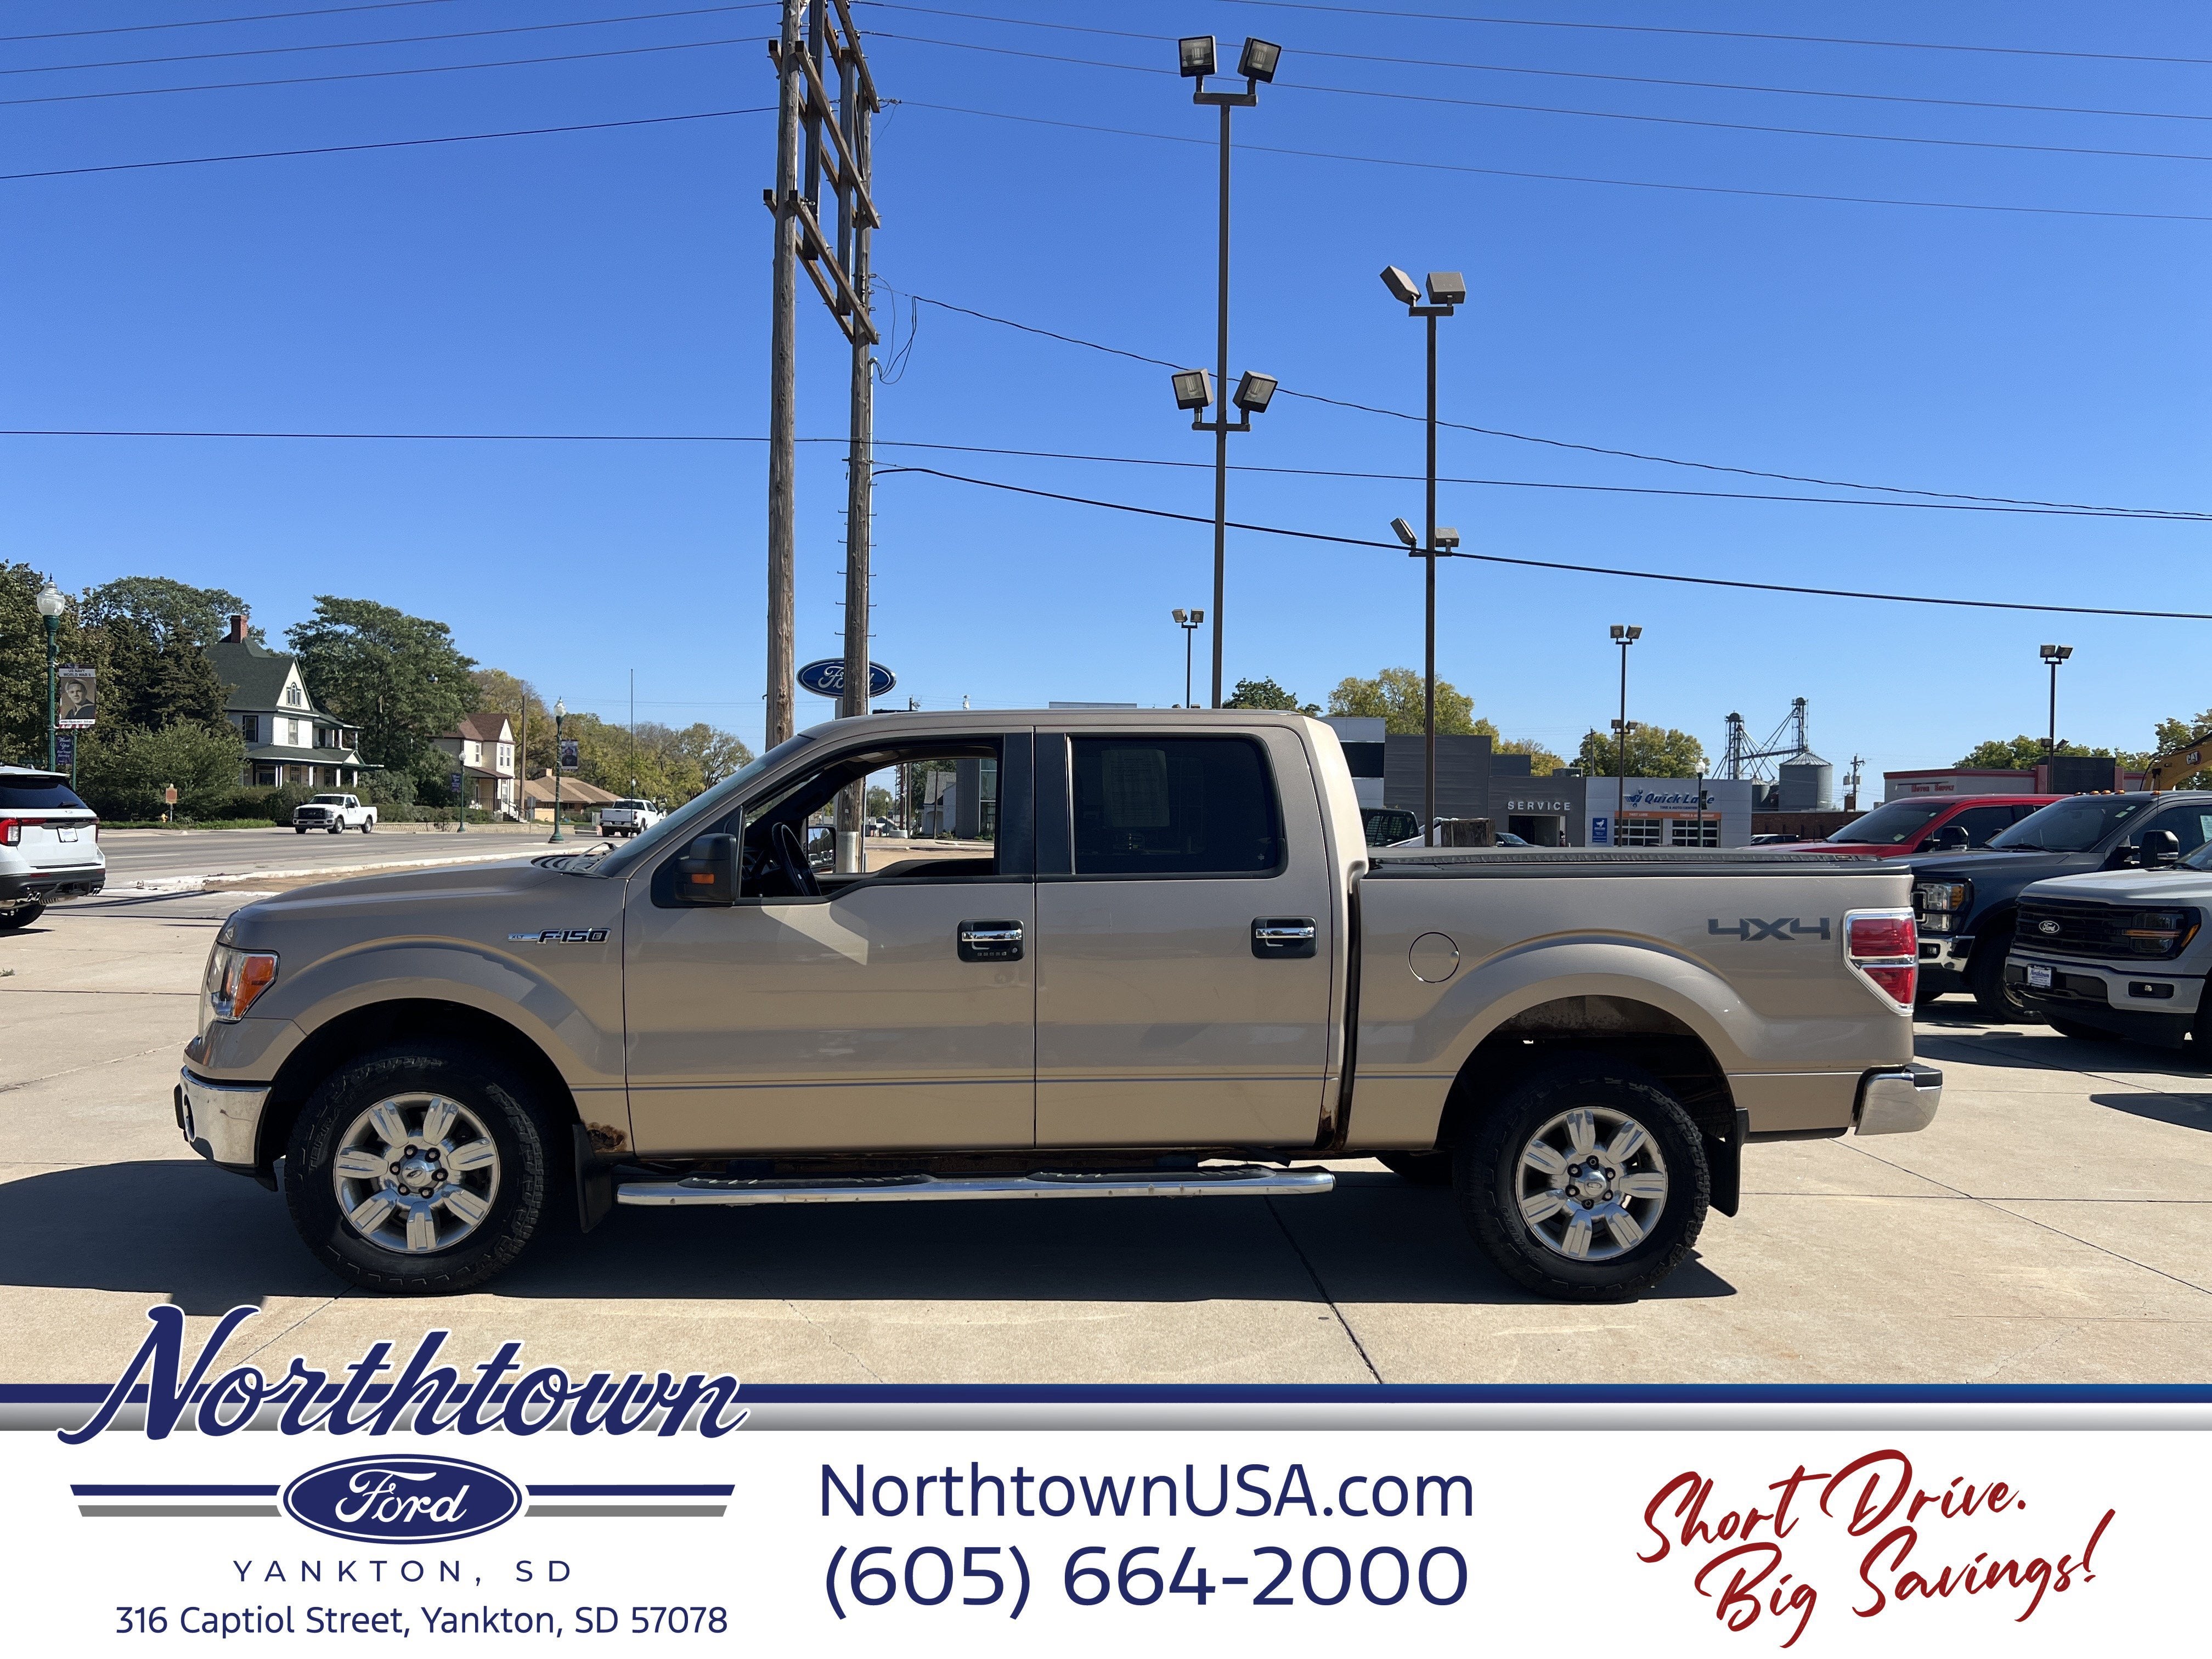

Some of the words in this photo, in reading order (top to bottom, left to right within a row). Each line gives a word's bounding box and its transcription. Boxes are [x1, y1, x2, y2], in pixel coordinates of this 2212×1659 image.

[817, 665, 874, 689] Fo
[2186, 751, 2198, 765] CAT
[1644, 793, 1680, 804] Quick
[1682, 794, 1715, 804] Lae
[1508, 801, 1571, 811] SERVICE
[1708, 917, 1831, 941] 4X4
[2042, 923, 2056, 931] Ford
[536, 928, 611, 945] F-150
